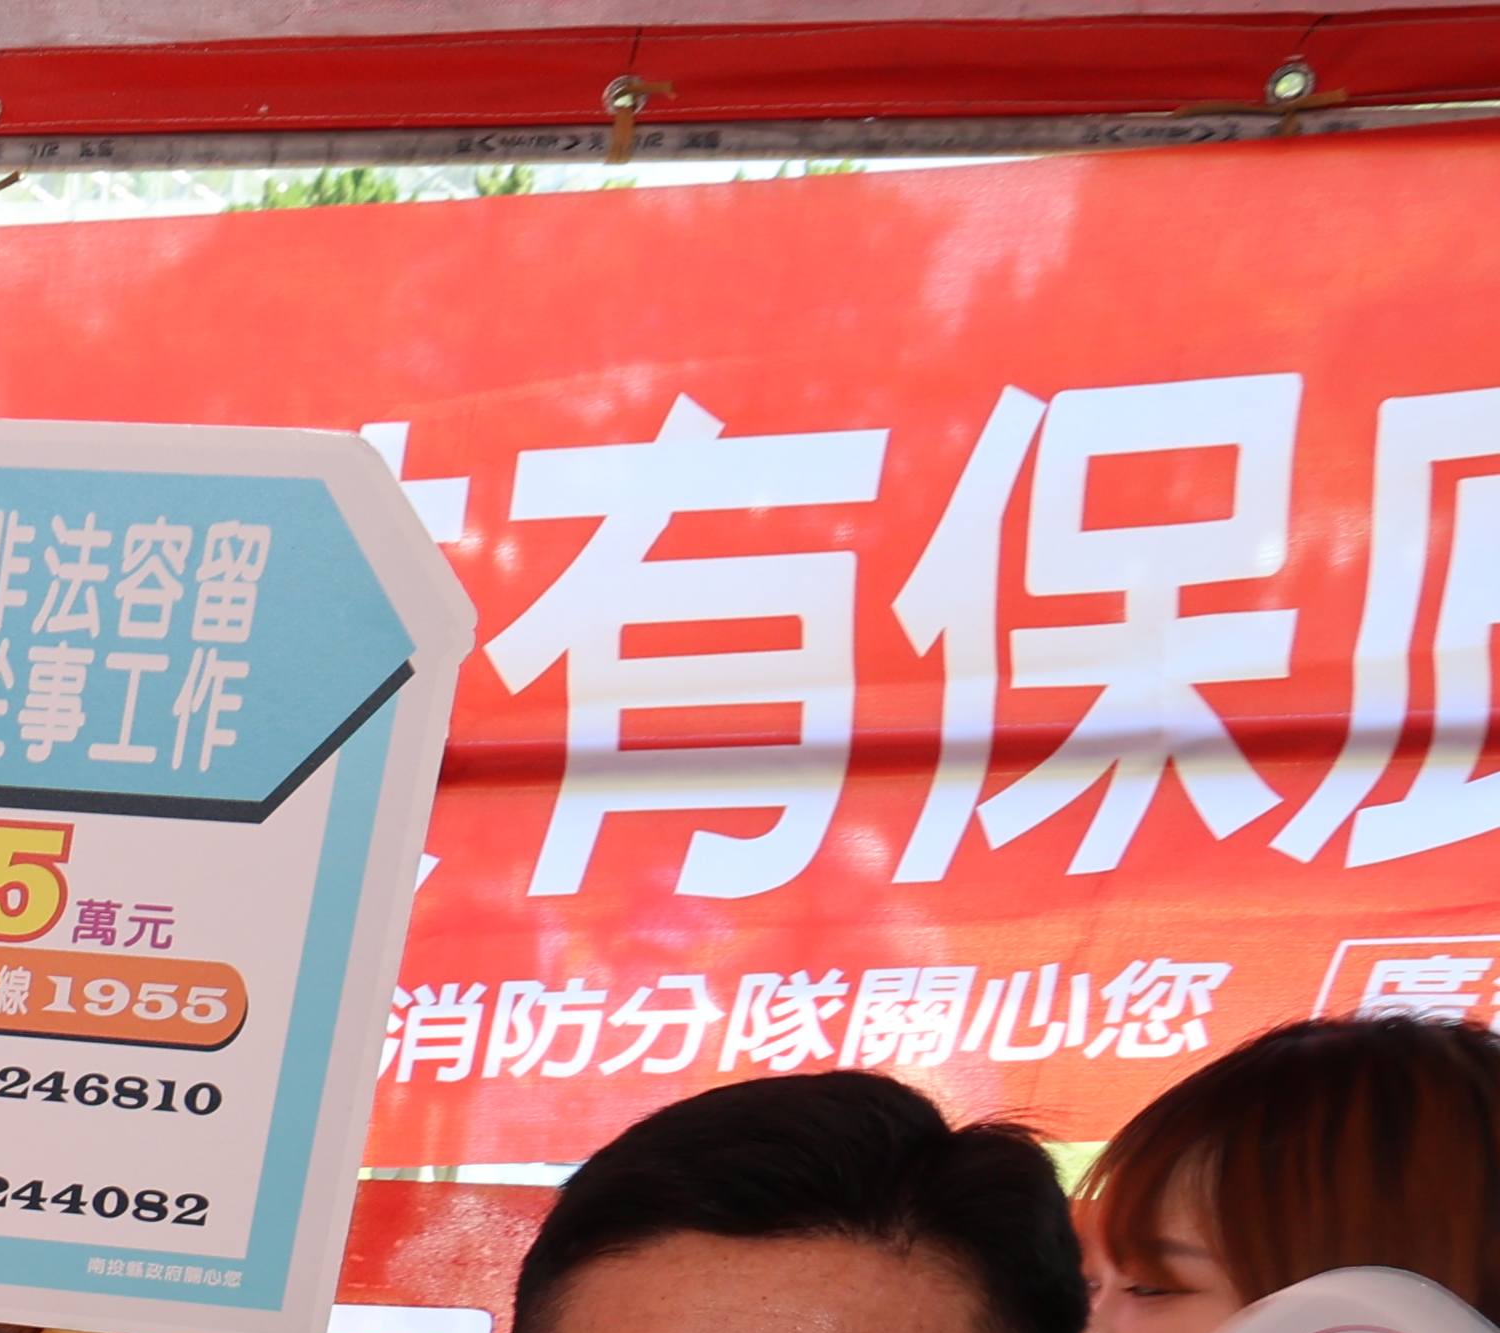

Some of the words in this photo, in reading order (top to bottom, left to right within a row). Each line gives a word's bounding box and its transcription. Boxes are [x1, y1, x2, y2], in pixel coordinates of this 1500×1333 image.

[72, 898, 178, 951] 萬元
[41, 971, 230, 1027] 1955
[375, 950, 1232, 1090] 消防分隊關心您
[86, 1256, 244, 1290] 南投縣政府關心您
